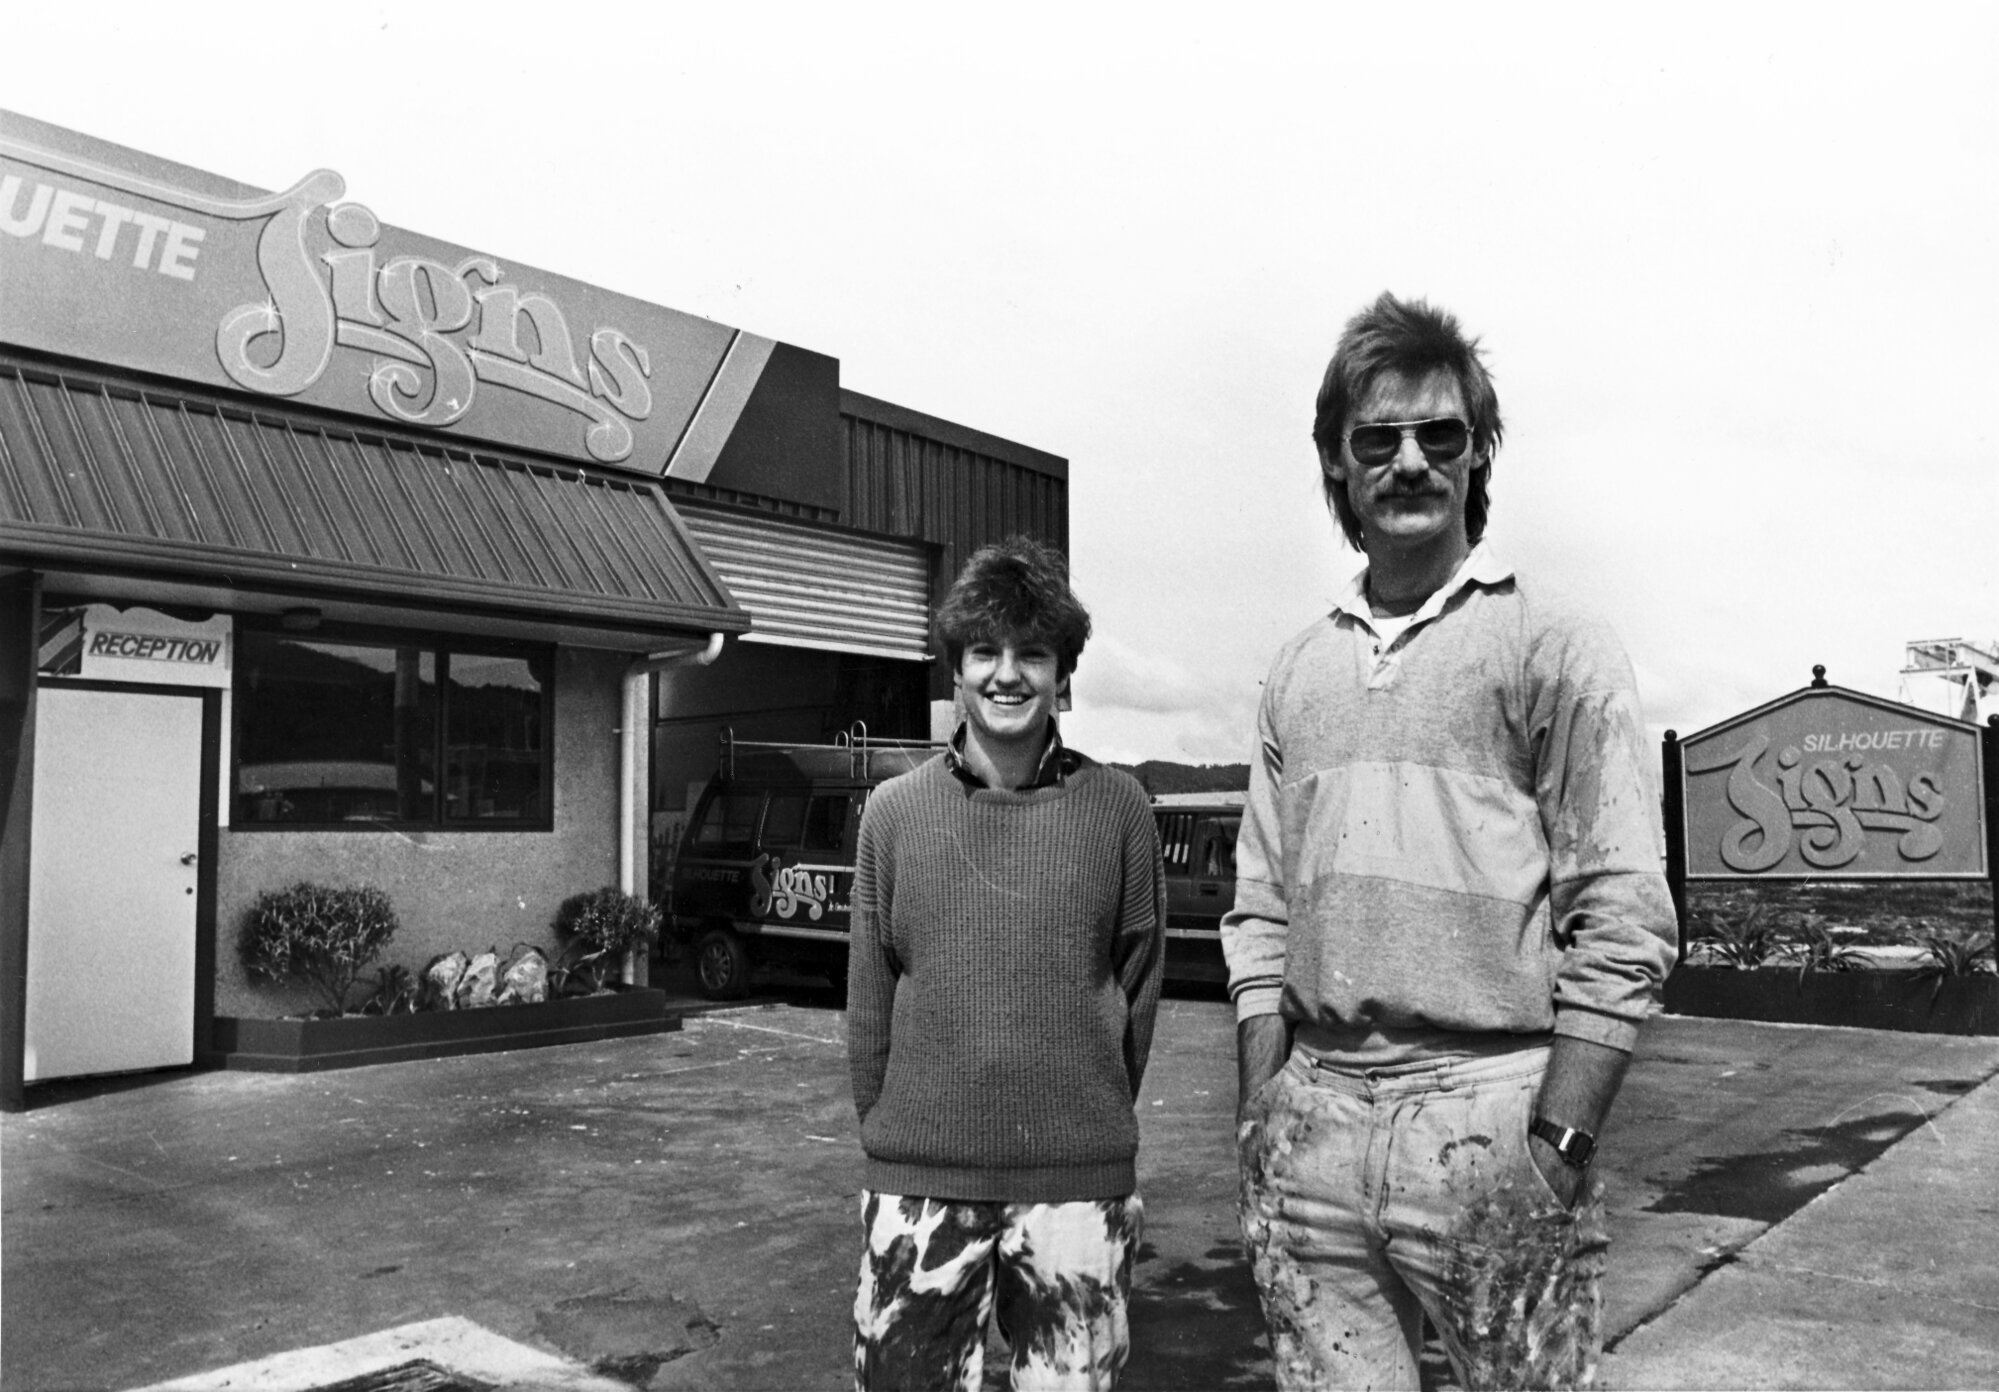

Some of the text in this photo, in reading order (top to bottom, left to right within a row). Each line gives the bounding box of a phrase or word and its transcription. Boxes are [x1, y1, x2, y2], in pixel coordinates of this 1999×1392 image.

[0, 168, 652, 462] UETTE Signs
[88, 632, 221, 663] RECEPTION
[1803, 729, 1946, 752] SILHOUETTE
[1690, 724, 1944, 874] Signs
[751, 853, 827, 921] Signs
